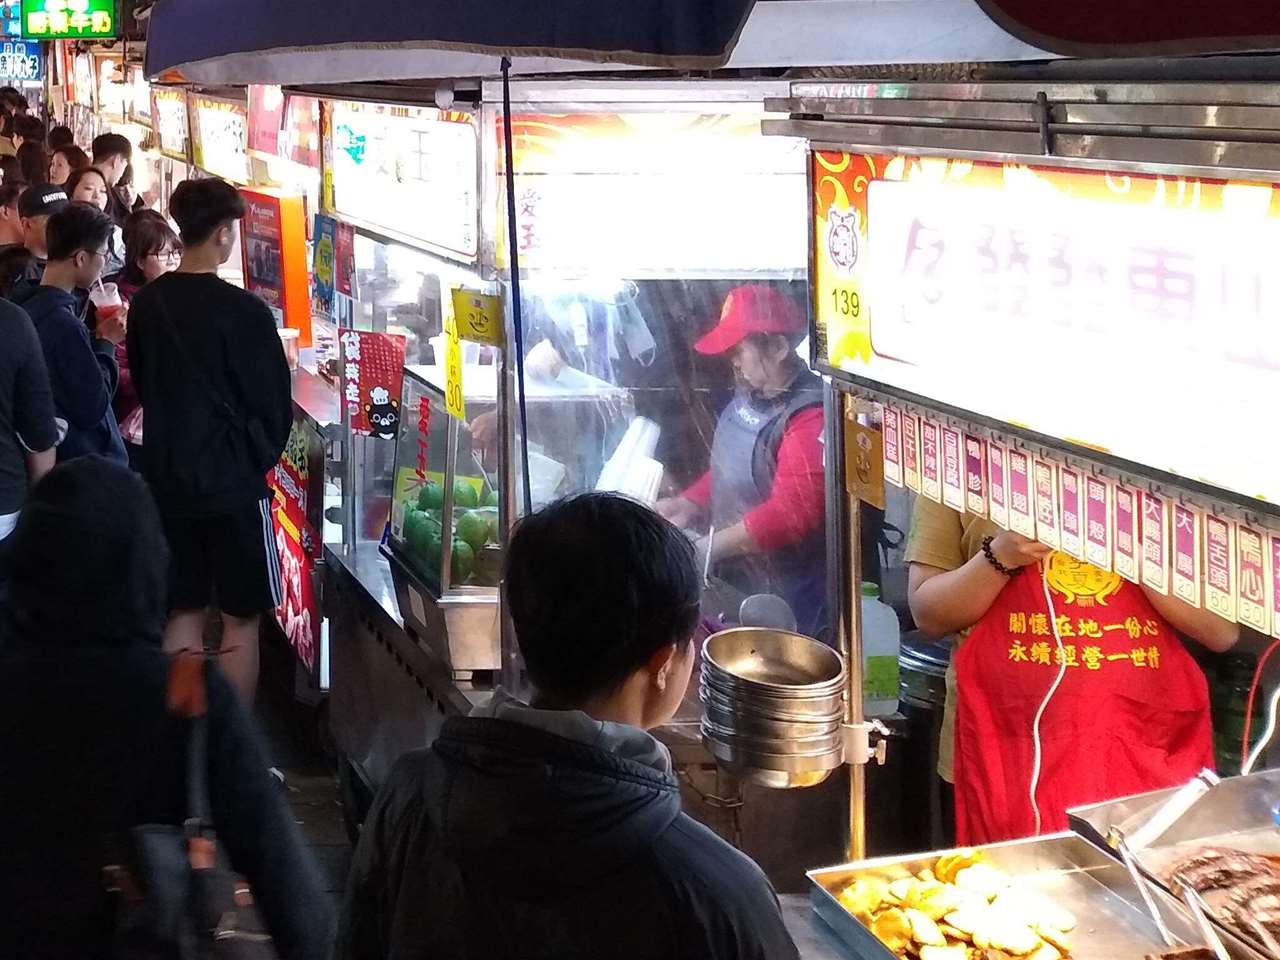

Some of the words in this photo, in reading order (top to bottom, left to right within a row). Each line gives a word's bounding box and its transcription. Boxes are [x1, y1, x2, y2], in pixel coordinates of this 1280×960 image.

[831, 288, 860, 318] 139
[1176, 512, 1193, 577] 大腸
[1009, 612, 1159, 639] 關懷在地一份心
[1008, 640, 1161, 670] 永續經營一世情
